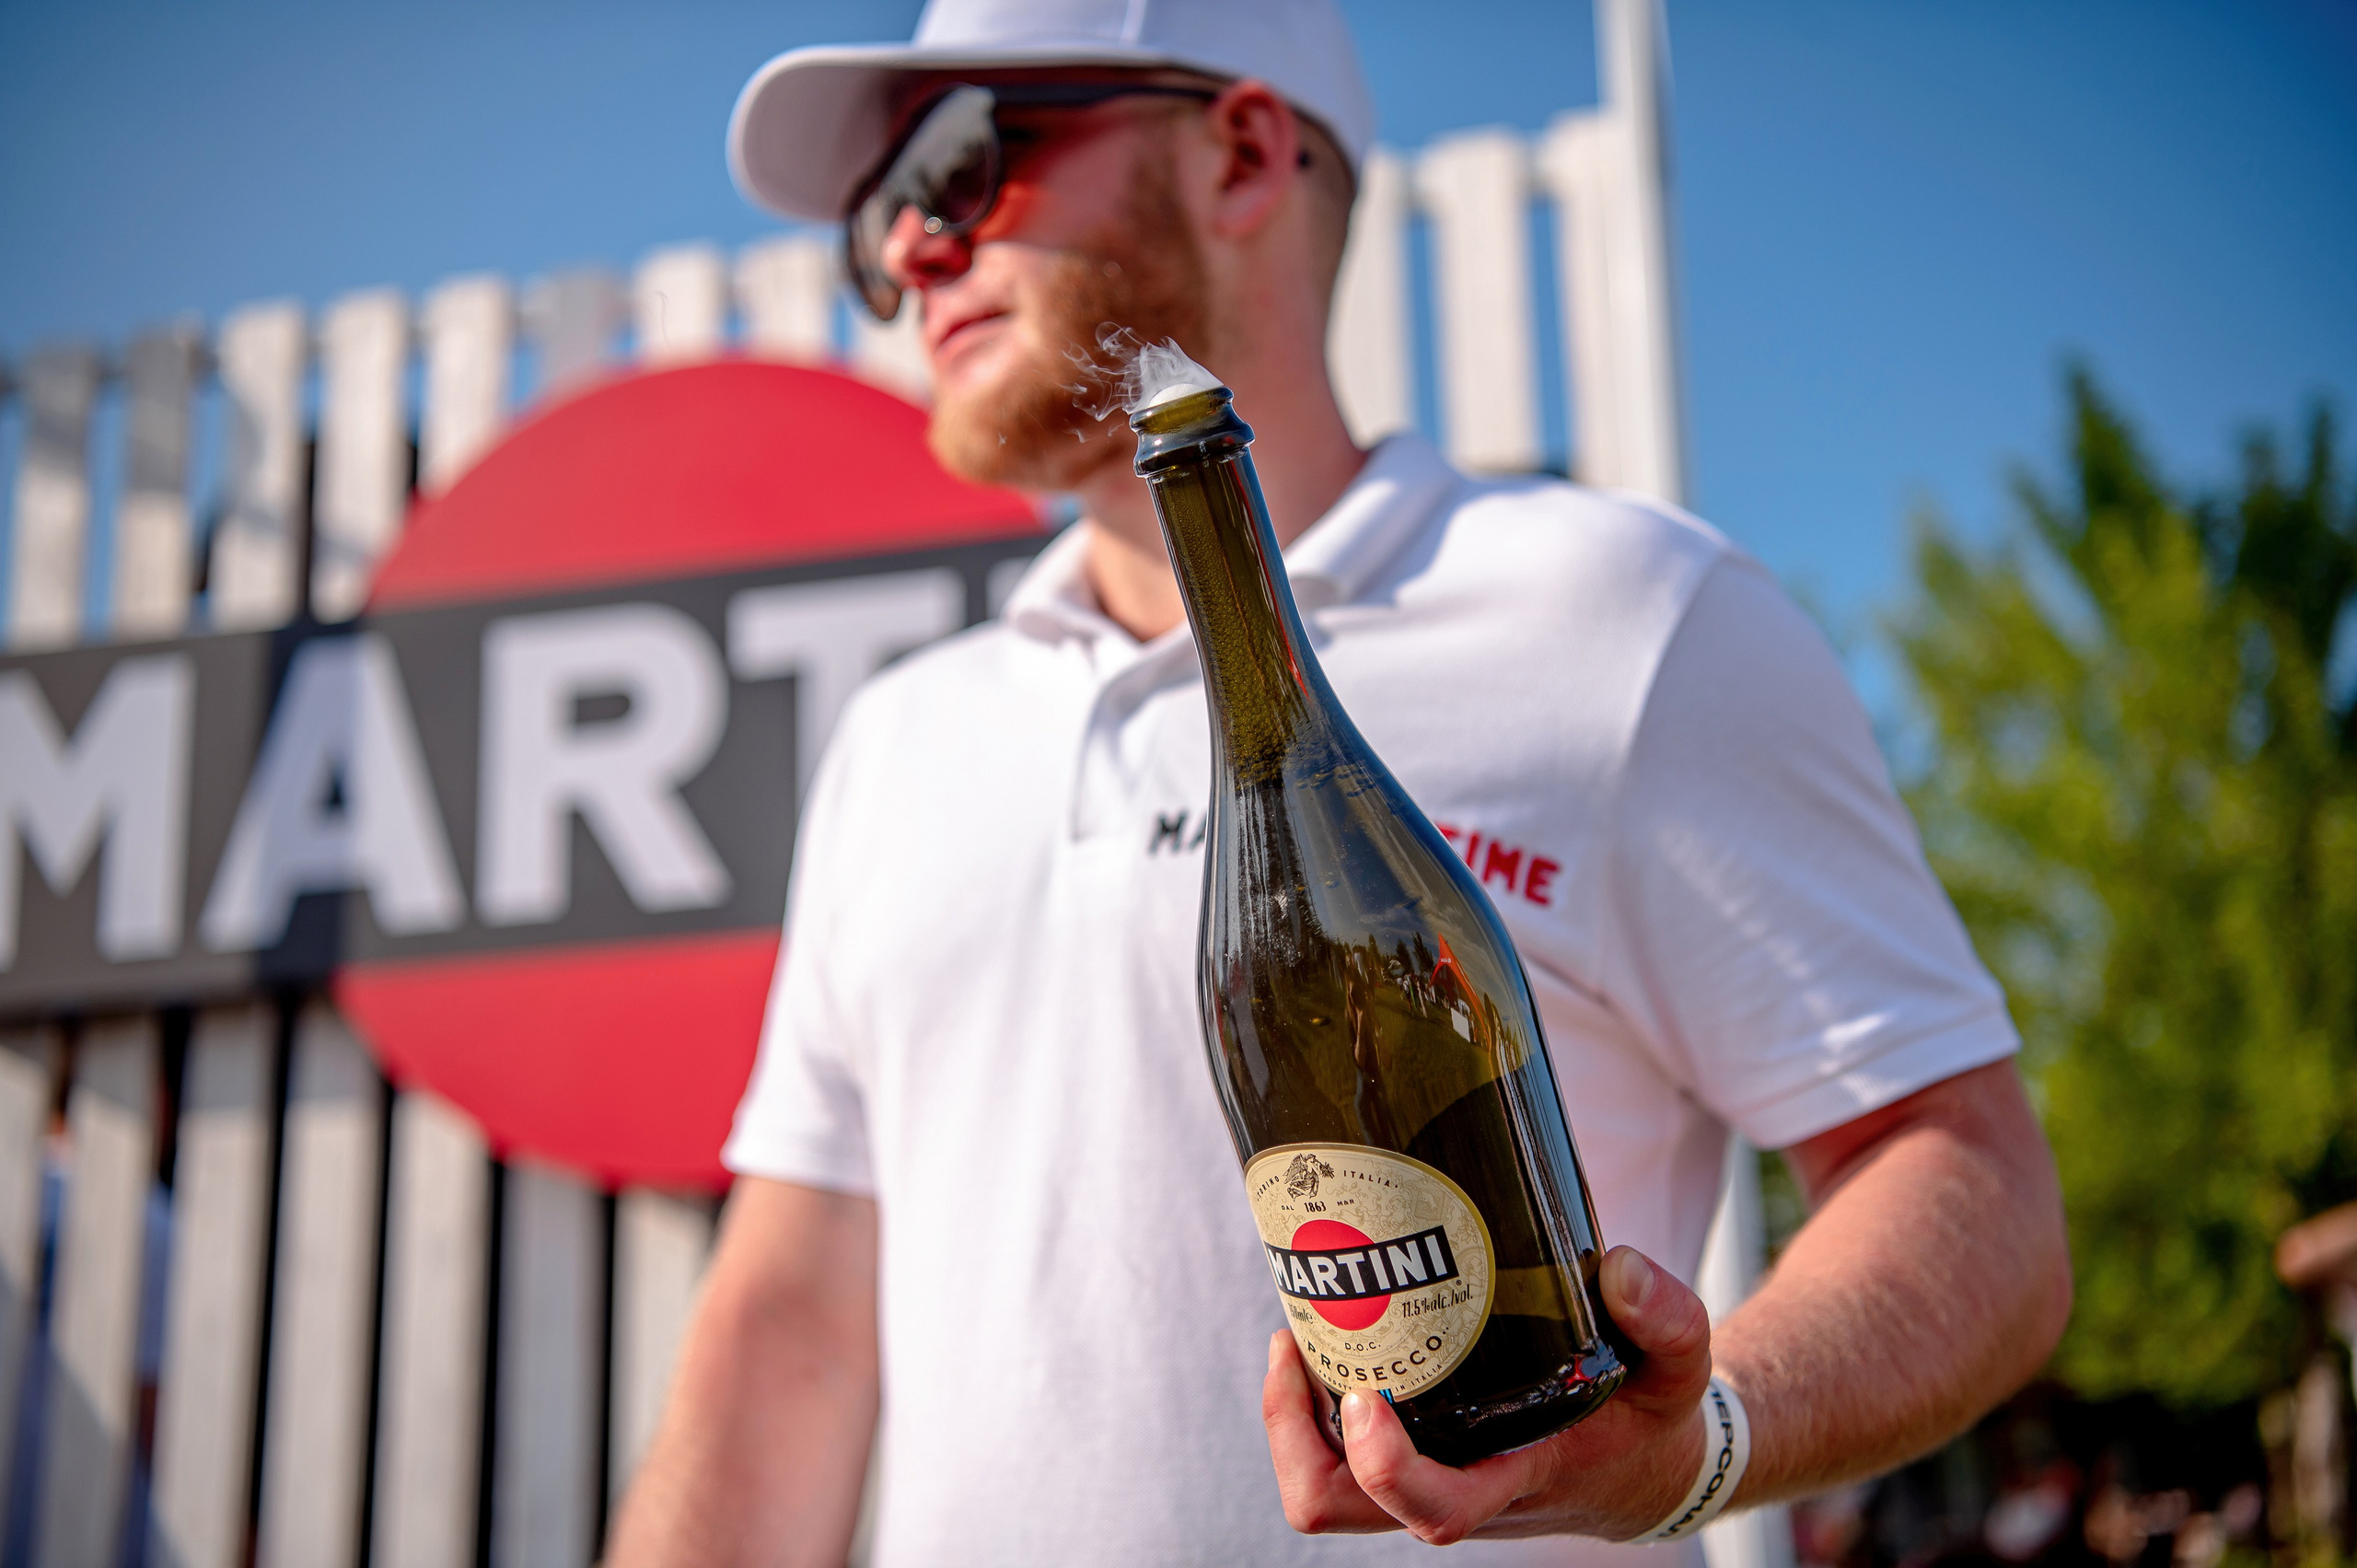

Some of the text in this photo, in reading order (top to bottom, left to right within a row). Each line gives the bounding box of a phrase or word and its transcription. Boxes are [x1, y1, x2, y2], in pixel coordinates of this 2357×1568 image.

[1304, 1201, 1327, 1213] 1863
[1267, 1234, 1448, 1296] MARTINI
[1306, 1335, 1443, 1382] PROSECCO
[1411, 1363, 1443, 1388] ITALIA
